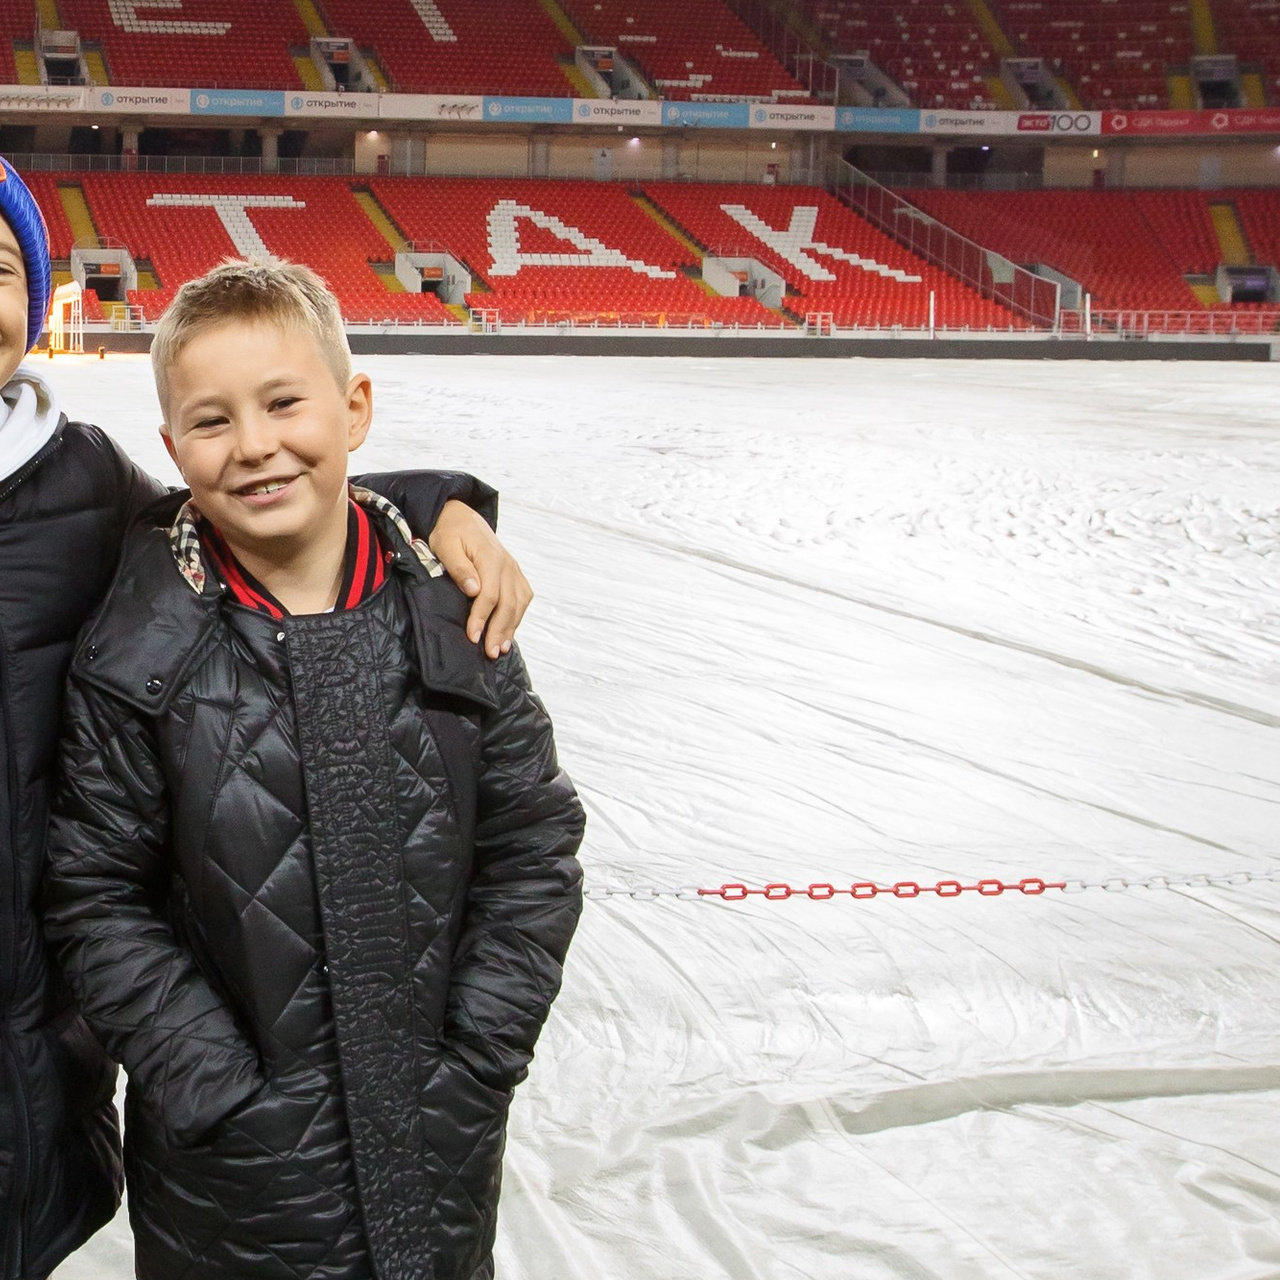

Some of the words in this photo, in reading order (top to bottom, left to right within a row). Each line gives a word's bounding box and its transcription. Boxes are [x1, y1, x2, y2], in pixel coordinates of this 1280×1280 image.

[116, 94, 168, 106] открытие
[306, 99, 357, 110] открытие
[593, 105, 642, 117] открытие
[769, 111, 816, 122] открытие
